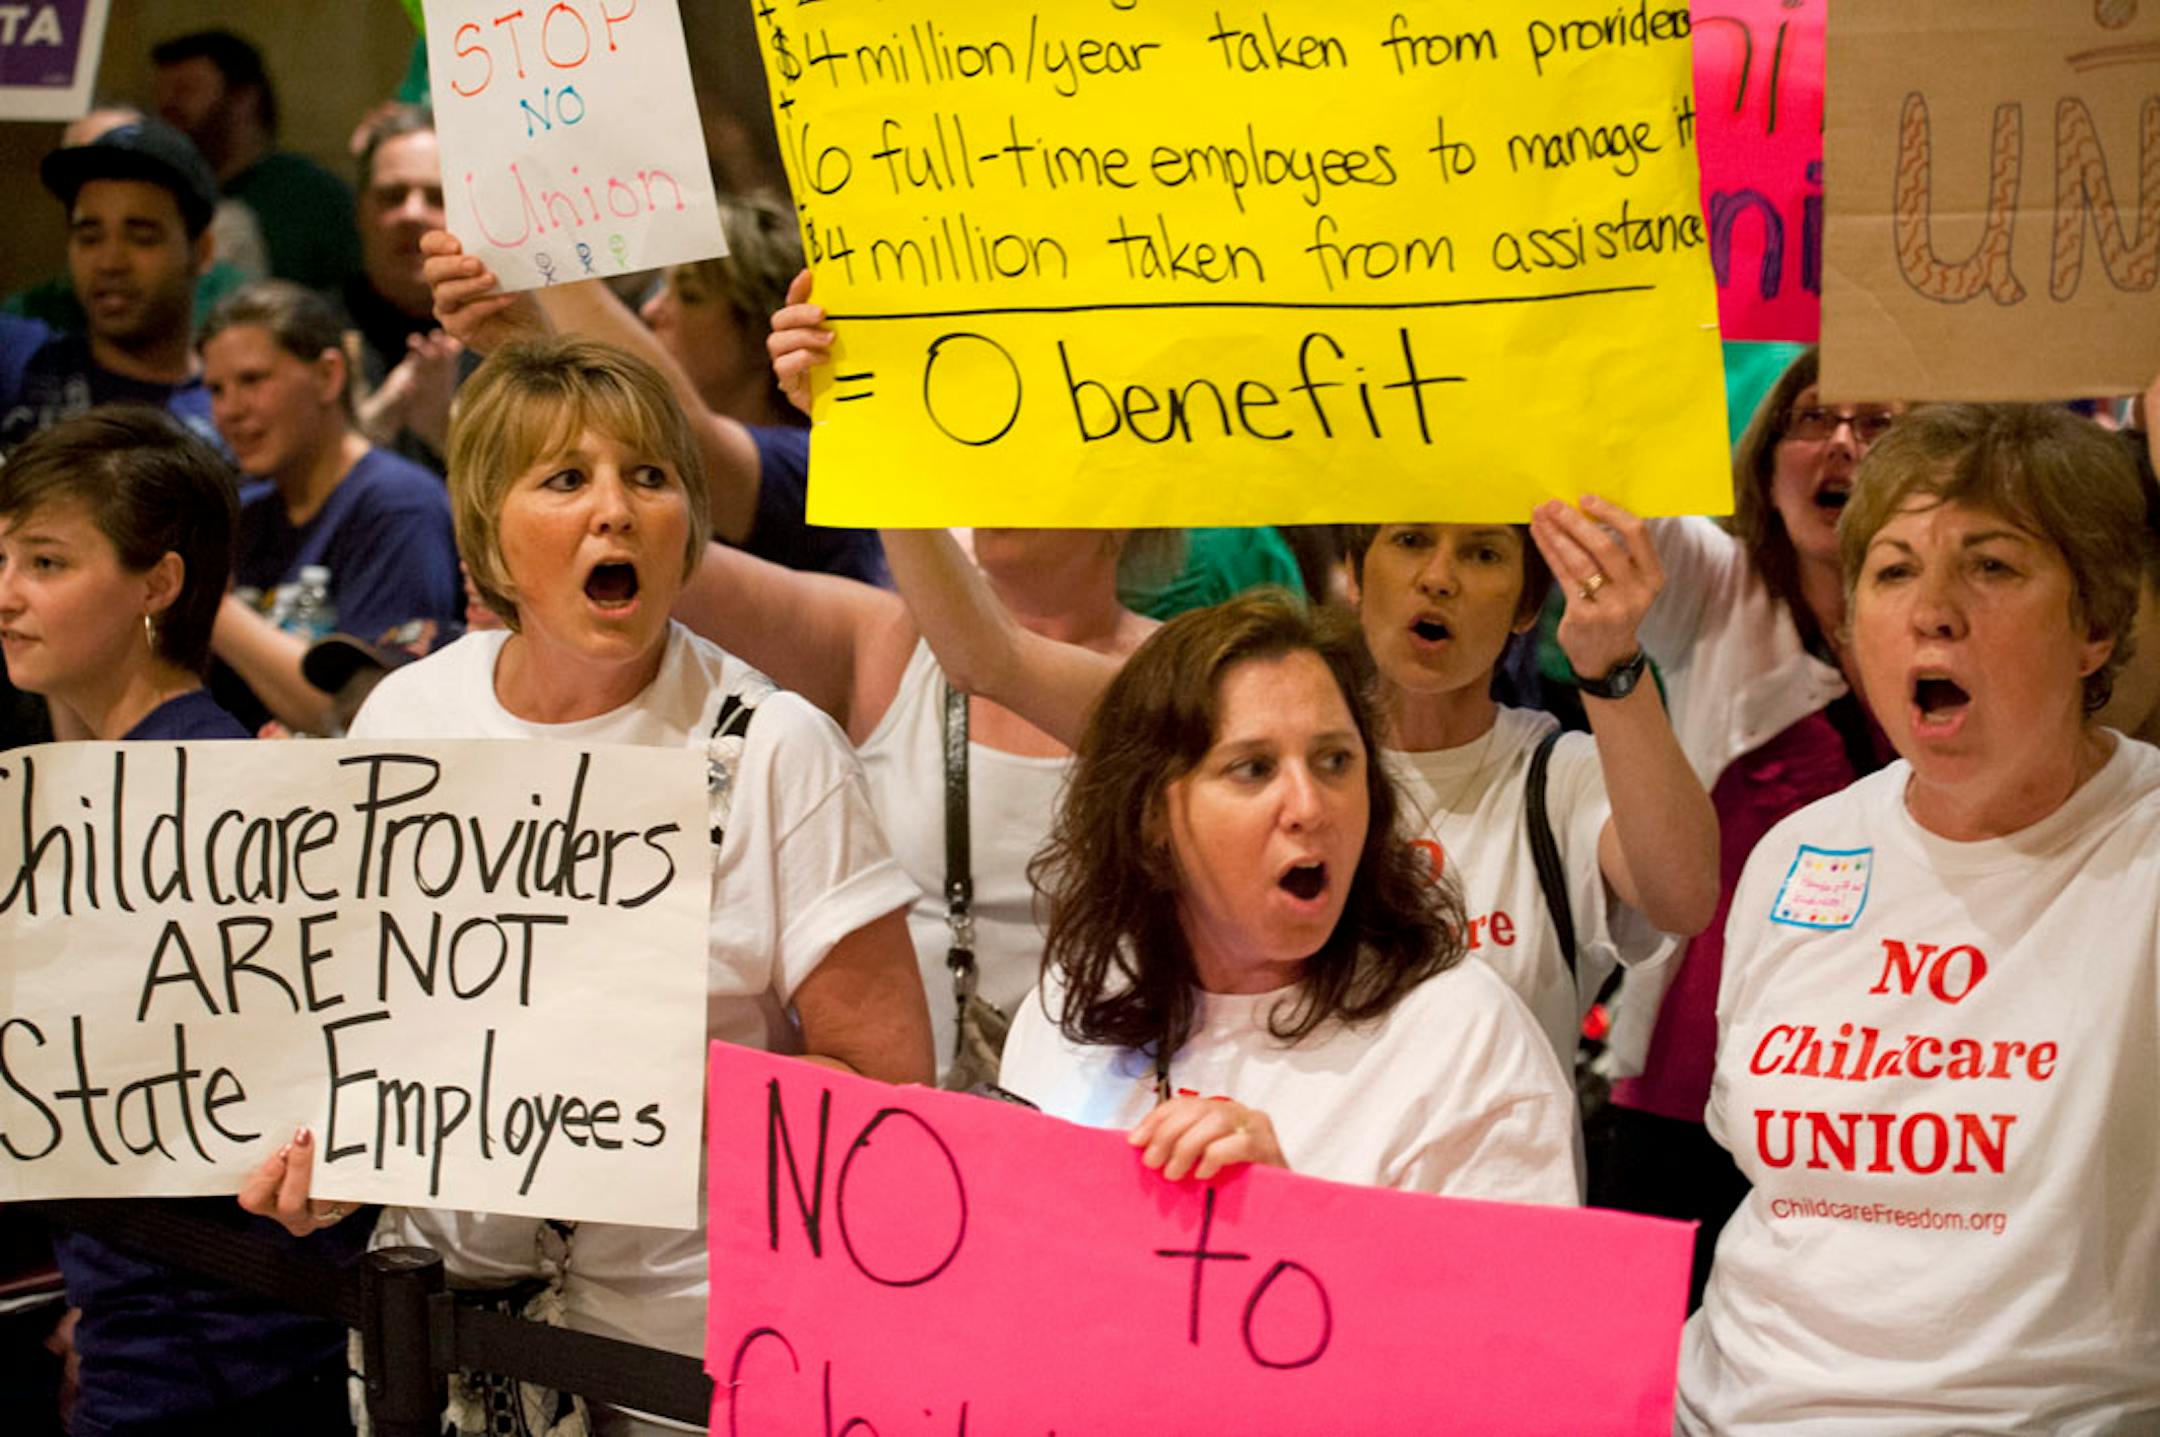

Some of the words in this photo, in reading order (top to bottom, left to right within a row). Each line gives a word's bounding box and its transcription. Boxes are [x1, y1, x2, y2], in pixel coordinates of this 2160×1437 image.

[451, 0, 638, 97] STOP
[1208, 12, 1348, 74] taken
[1382, 14, 1498, 76] from
[519, 85, 585, 138] NO
[871, 112, 1138, 194] full-time
[1151, 123, 1397, 213] employees
[1429, 116, 1476, 183] to
[1508, 122, 1661, 177] manage
[1672, 96, 1696, 152] it
[465, 162, 685, 249] Union
[1709, 160, 1824, 302] ni
[870, 213, 1068, 285] million
[1108, 213, 1265, 284] taken
[1305, 215, 1455, 291] from
[1058, 327, 1468, 445] benefit
[0, 747, 340, 917] hildcare
[338, 753, 682, 908] Providers
[138, 910, 346, 1022] ARE
[378, 911, 569, 1006] NOT
[1869, 939, 1989, 1005] NO
[1748, 1022, 2059, 1082] Childcare
[0, 1015, 262, 1166] State
[323, 1010, 667, 1197] Employees
[1753, 1109, 2018, 1175] UNION
[767, 1077, 968, 1289] NO
[1155, 1187, 1332, 1370] to
[1771, 1198, 2008, 1235] ChildcareFreedom.org
